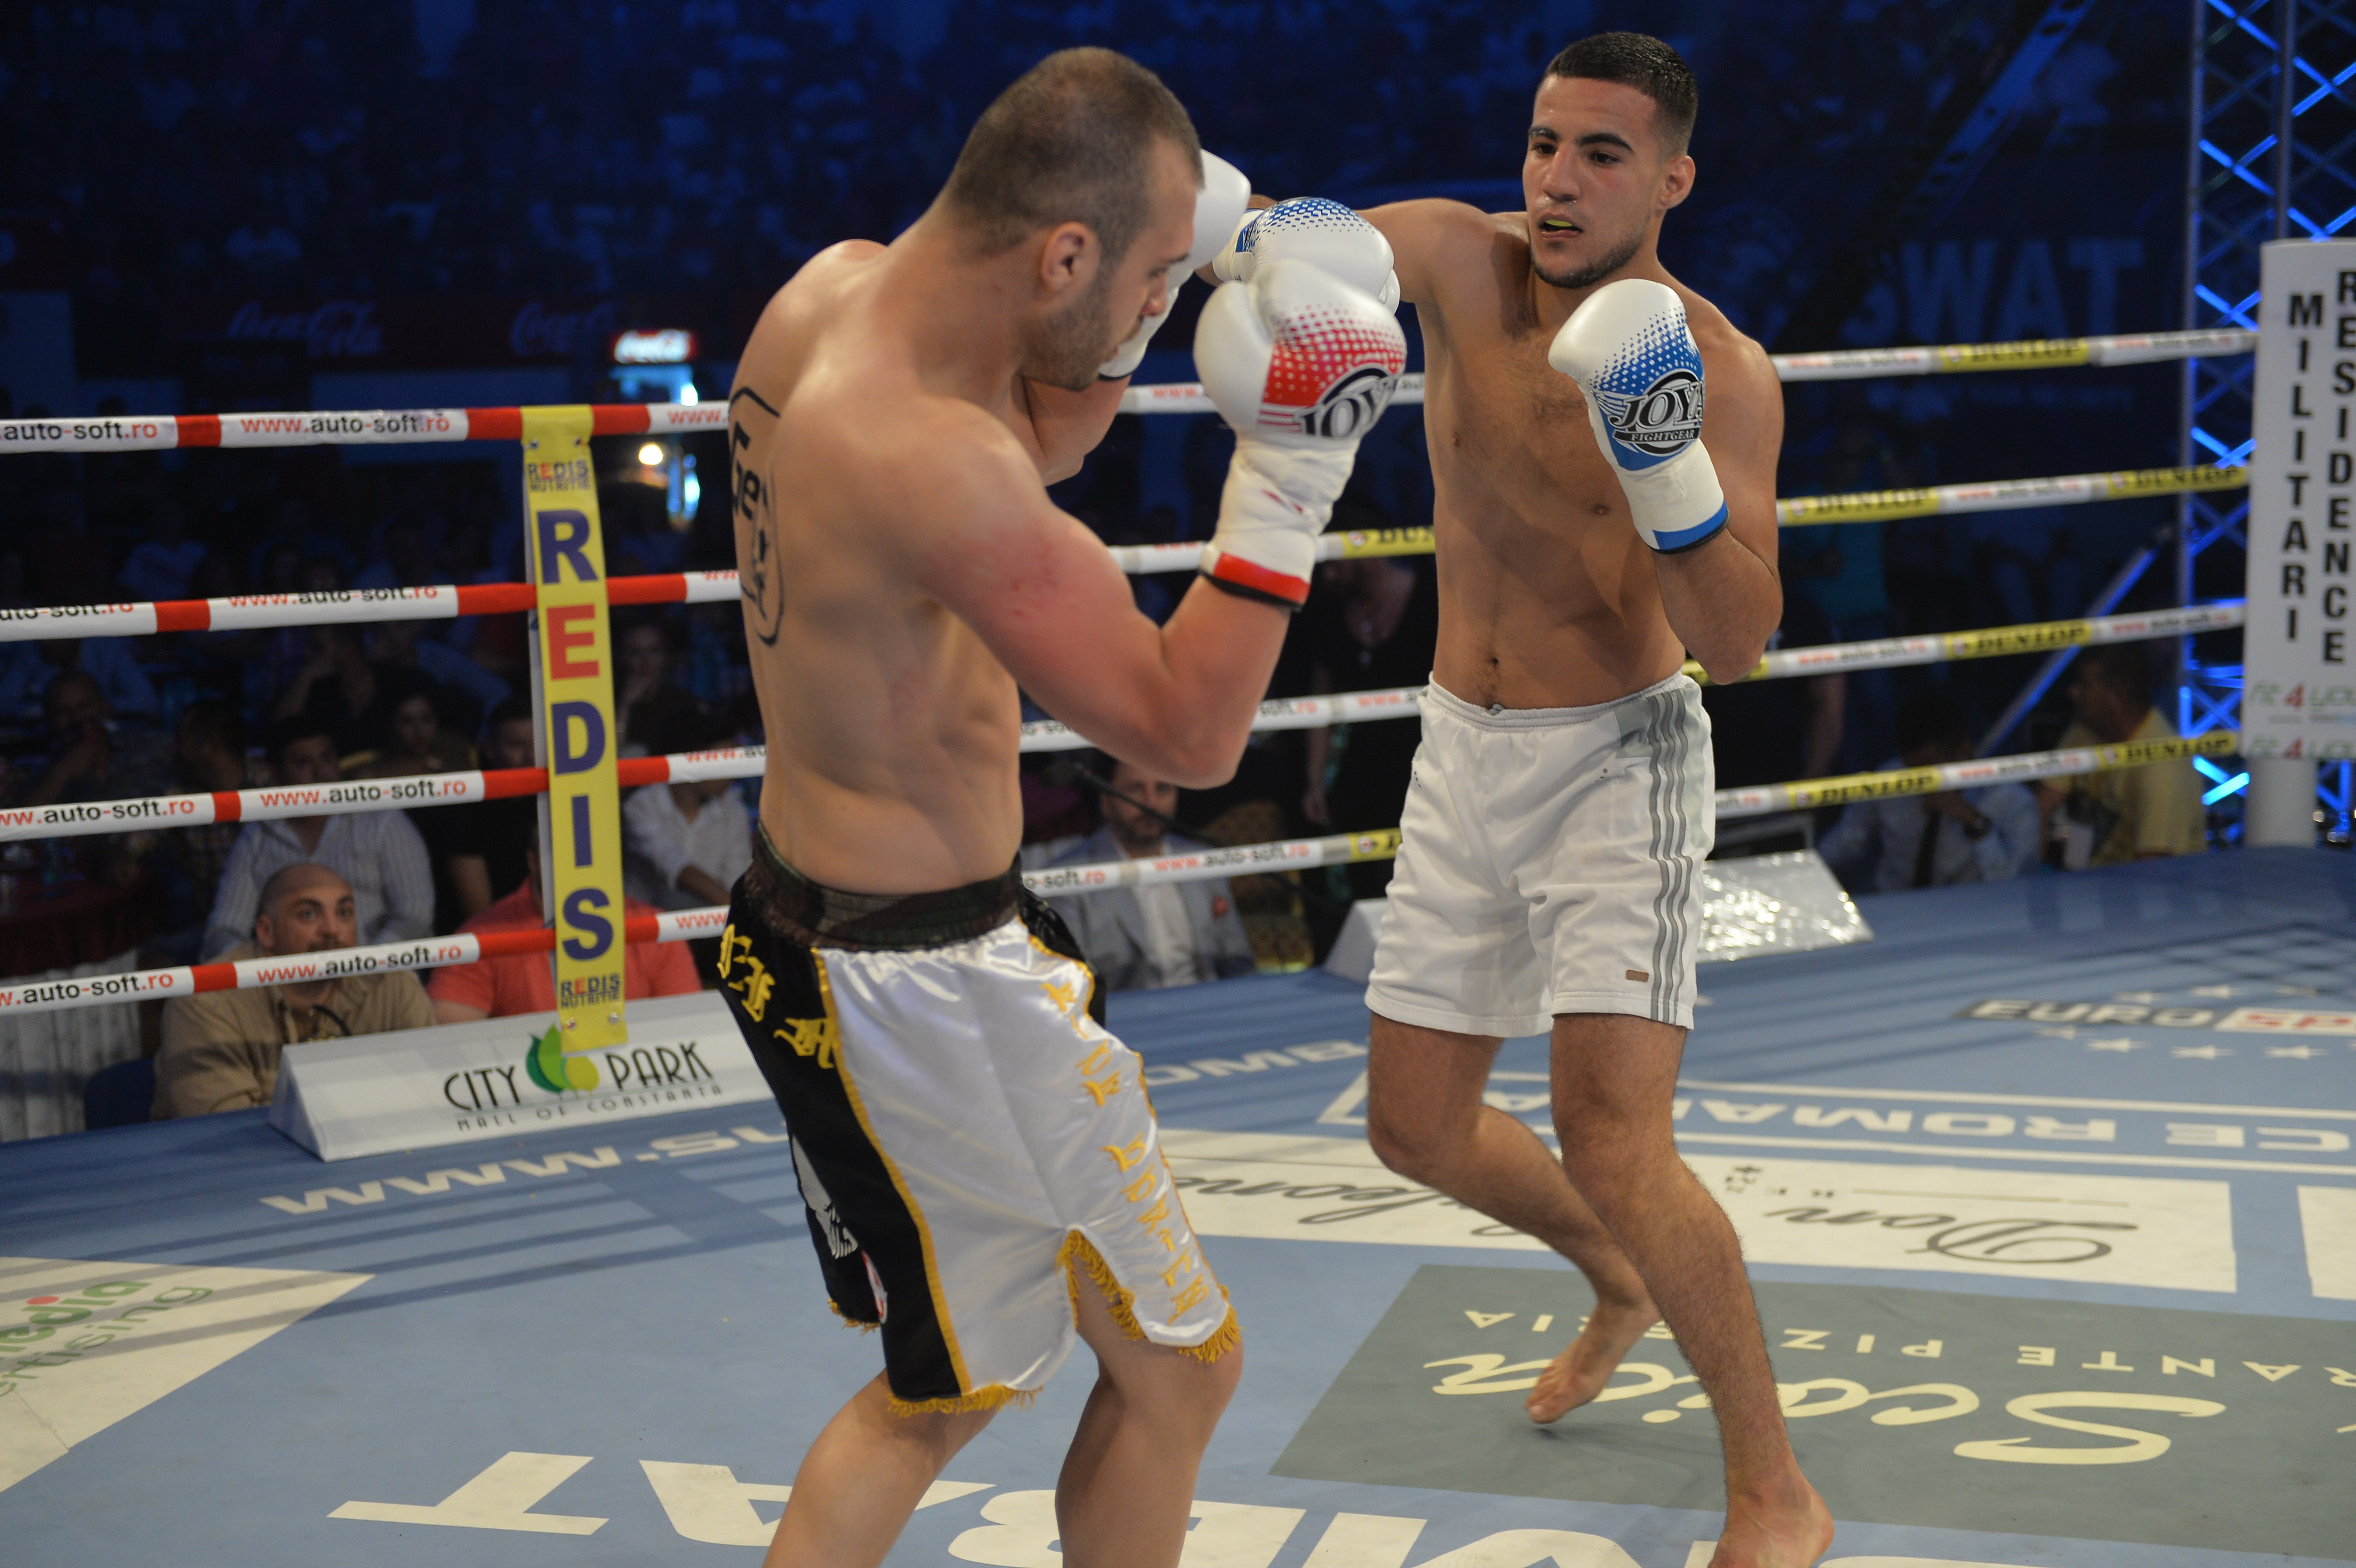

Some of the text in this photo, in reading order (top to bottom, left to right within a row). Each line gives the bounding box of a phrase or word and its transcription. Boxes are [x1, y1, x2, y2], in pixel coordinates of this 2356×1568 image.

[240, 414, 450, 433] www.auto-soft.ro
[1631, 430, 1695, 441] FIGHTGEAR
[527, 460, 589, 481] REDIS
[2281, 294, 2323, 640] MILITARI
[2323, 271, 2356, 663] RESIDENCE
[536, 508, 614, 962] REDIS
[260, 782, 467, 806] www.auto-soft.ro
[257, 946, 462, 983] www.auto-soft.ro
[560, 973, 621, 997] REDIS
[443, 1041, 714, 1111] CITY PARK
[457, 1114, 516, 1131] MALL
[536, 1107, 565, 1120] OF
